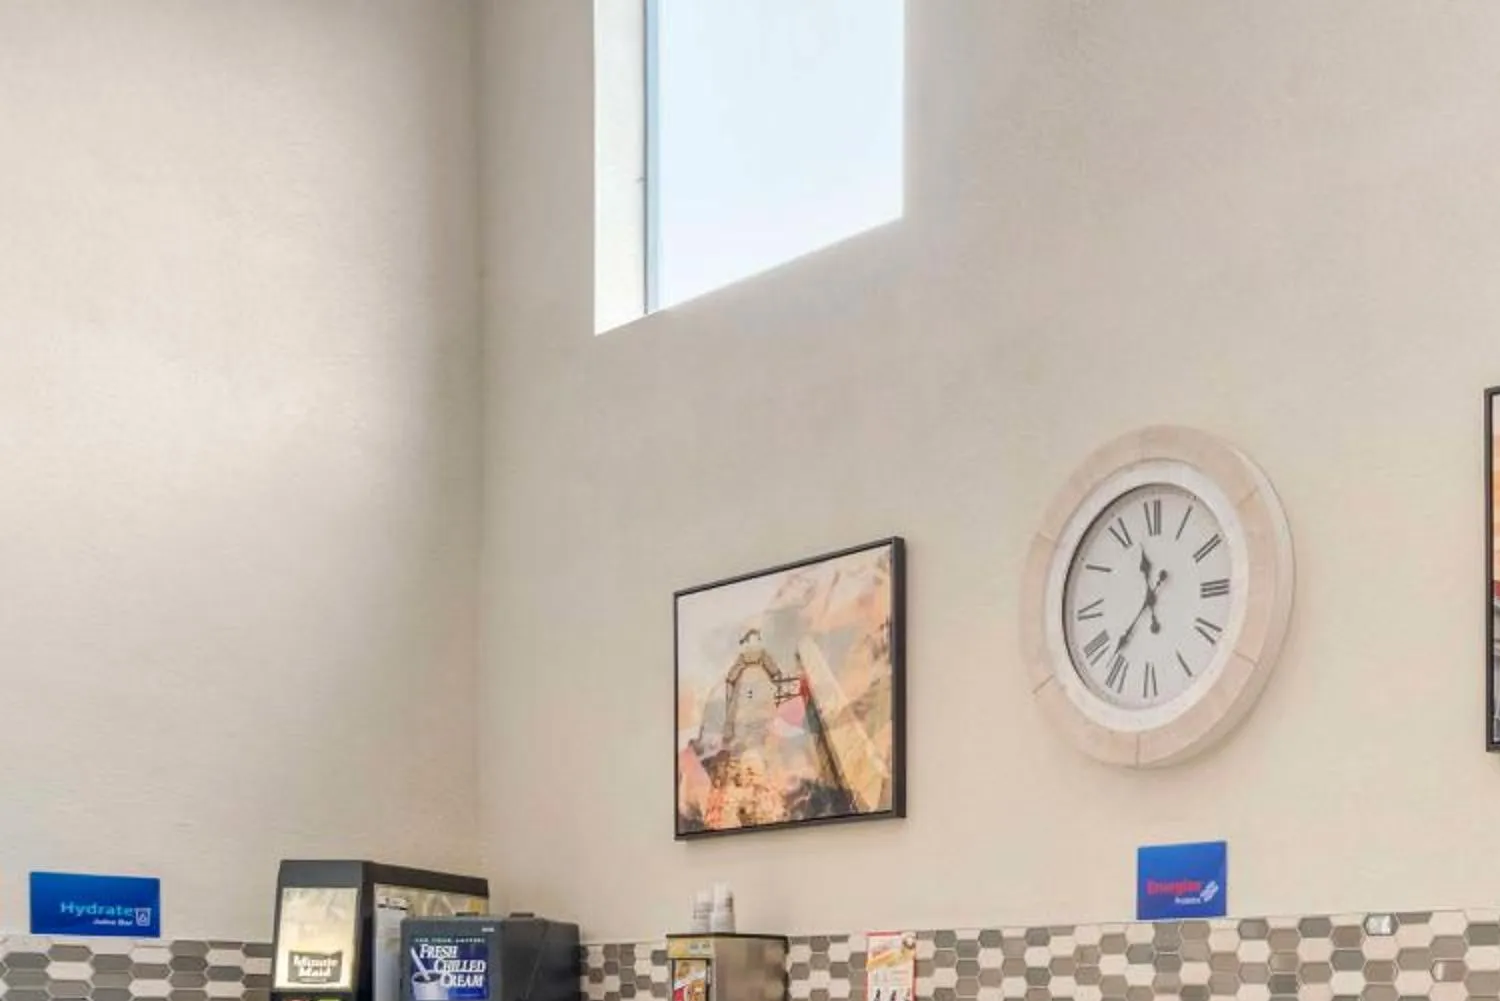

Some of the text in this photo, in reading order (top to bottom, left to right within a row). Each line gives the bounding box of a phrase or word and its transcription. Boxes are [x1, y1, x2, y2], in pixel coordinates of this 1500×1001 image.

[60, 901, 134, 917] Hydrate
[419, 943, 458, 959] FRESH
[434, 957, 487, 973] CHILLED
[441, 972, 485, 988] CREAM
